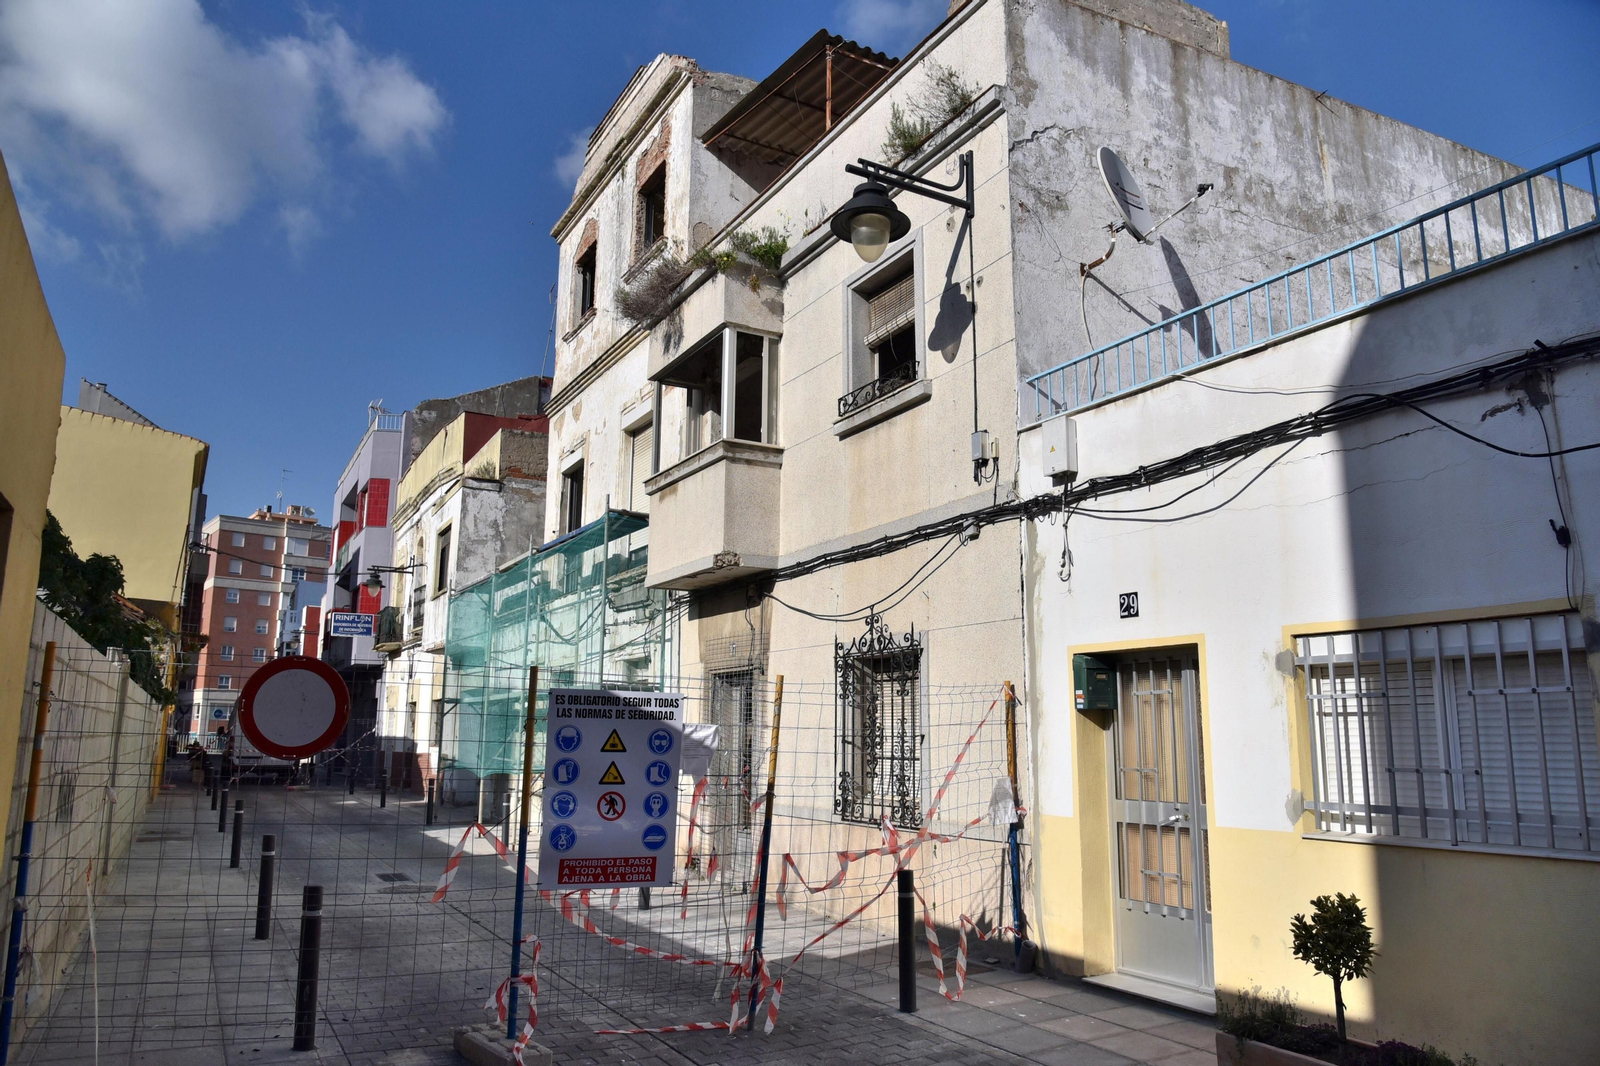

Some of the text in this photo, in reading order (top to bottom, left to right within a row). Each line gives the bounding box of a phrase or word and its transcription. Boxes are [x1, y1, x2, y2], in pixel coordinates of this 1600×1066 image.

[1120, 594, 1138, 615] 29
[555, 695, 680, 708] ES OBLIGATORIO SEGUIR TODAS
[556, 708, 677, 721] LAS NORMAS DE SEGURIDAD.
[563, 859, 614, 867] PROHIBIDO
[607, 866, 652, 874] PERSONA
[562, 875, 594, 883] AJENA
